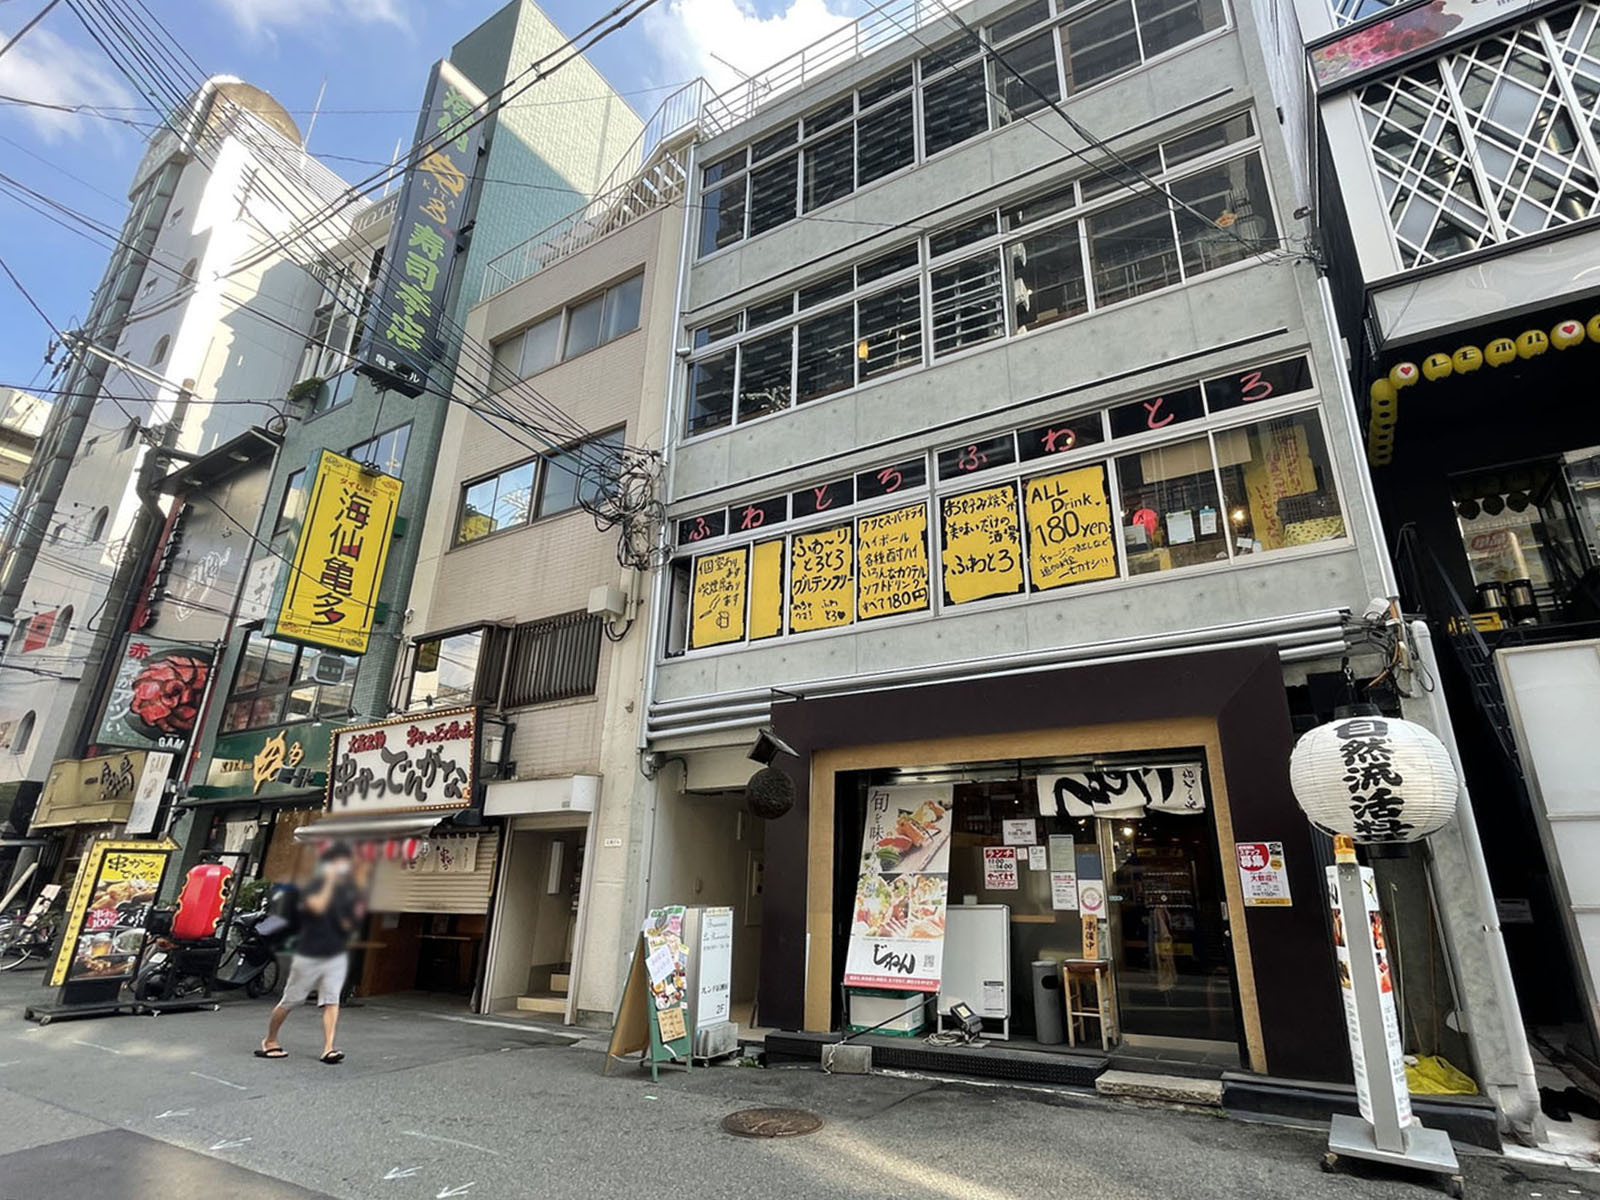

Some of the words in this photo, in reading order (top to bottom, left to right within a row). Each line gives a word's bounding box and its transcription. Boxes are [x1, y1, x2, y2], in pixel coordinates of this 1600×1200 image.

[1031, 481, 1068, 504] ALL
[1051, 493, 1092, 514] Drink
[948, 515, 1010, 541] 美味いだけの
[988, 525, 1018, 545] 酒場
[860, 532, 909, 550] ハイボール
[311, 488, 372, 626] 海仙亀多
[804, 548, 844, 573] とろとろ
[865, 544, 918, 567] 各種酎ハイ
[951, 549, 1014, 575] ふわとろ
[793, 574, 854, 595] グルテンフリー
[864, 580, 920, 595] ソフトドリンク
[334, 745, 468, 806] 串かつでんがな
